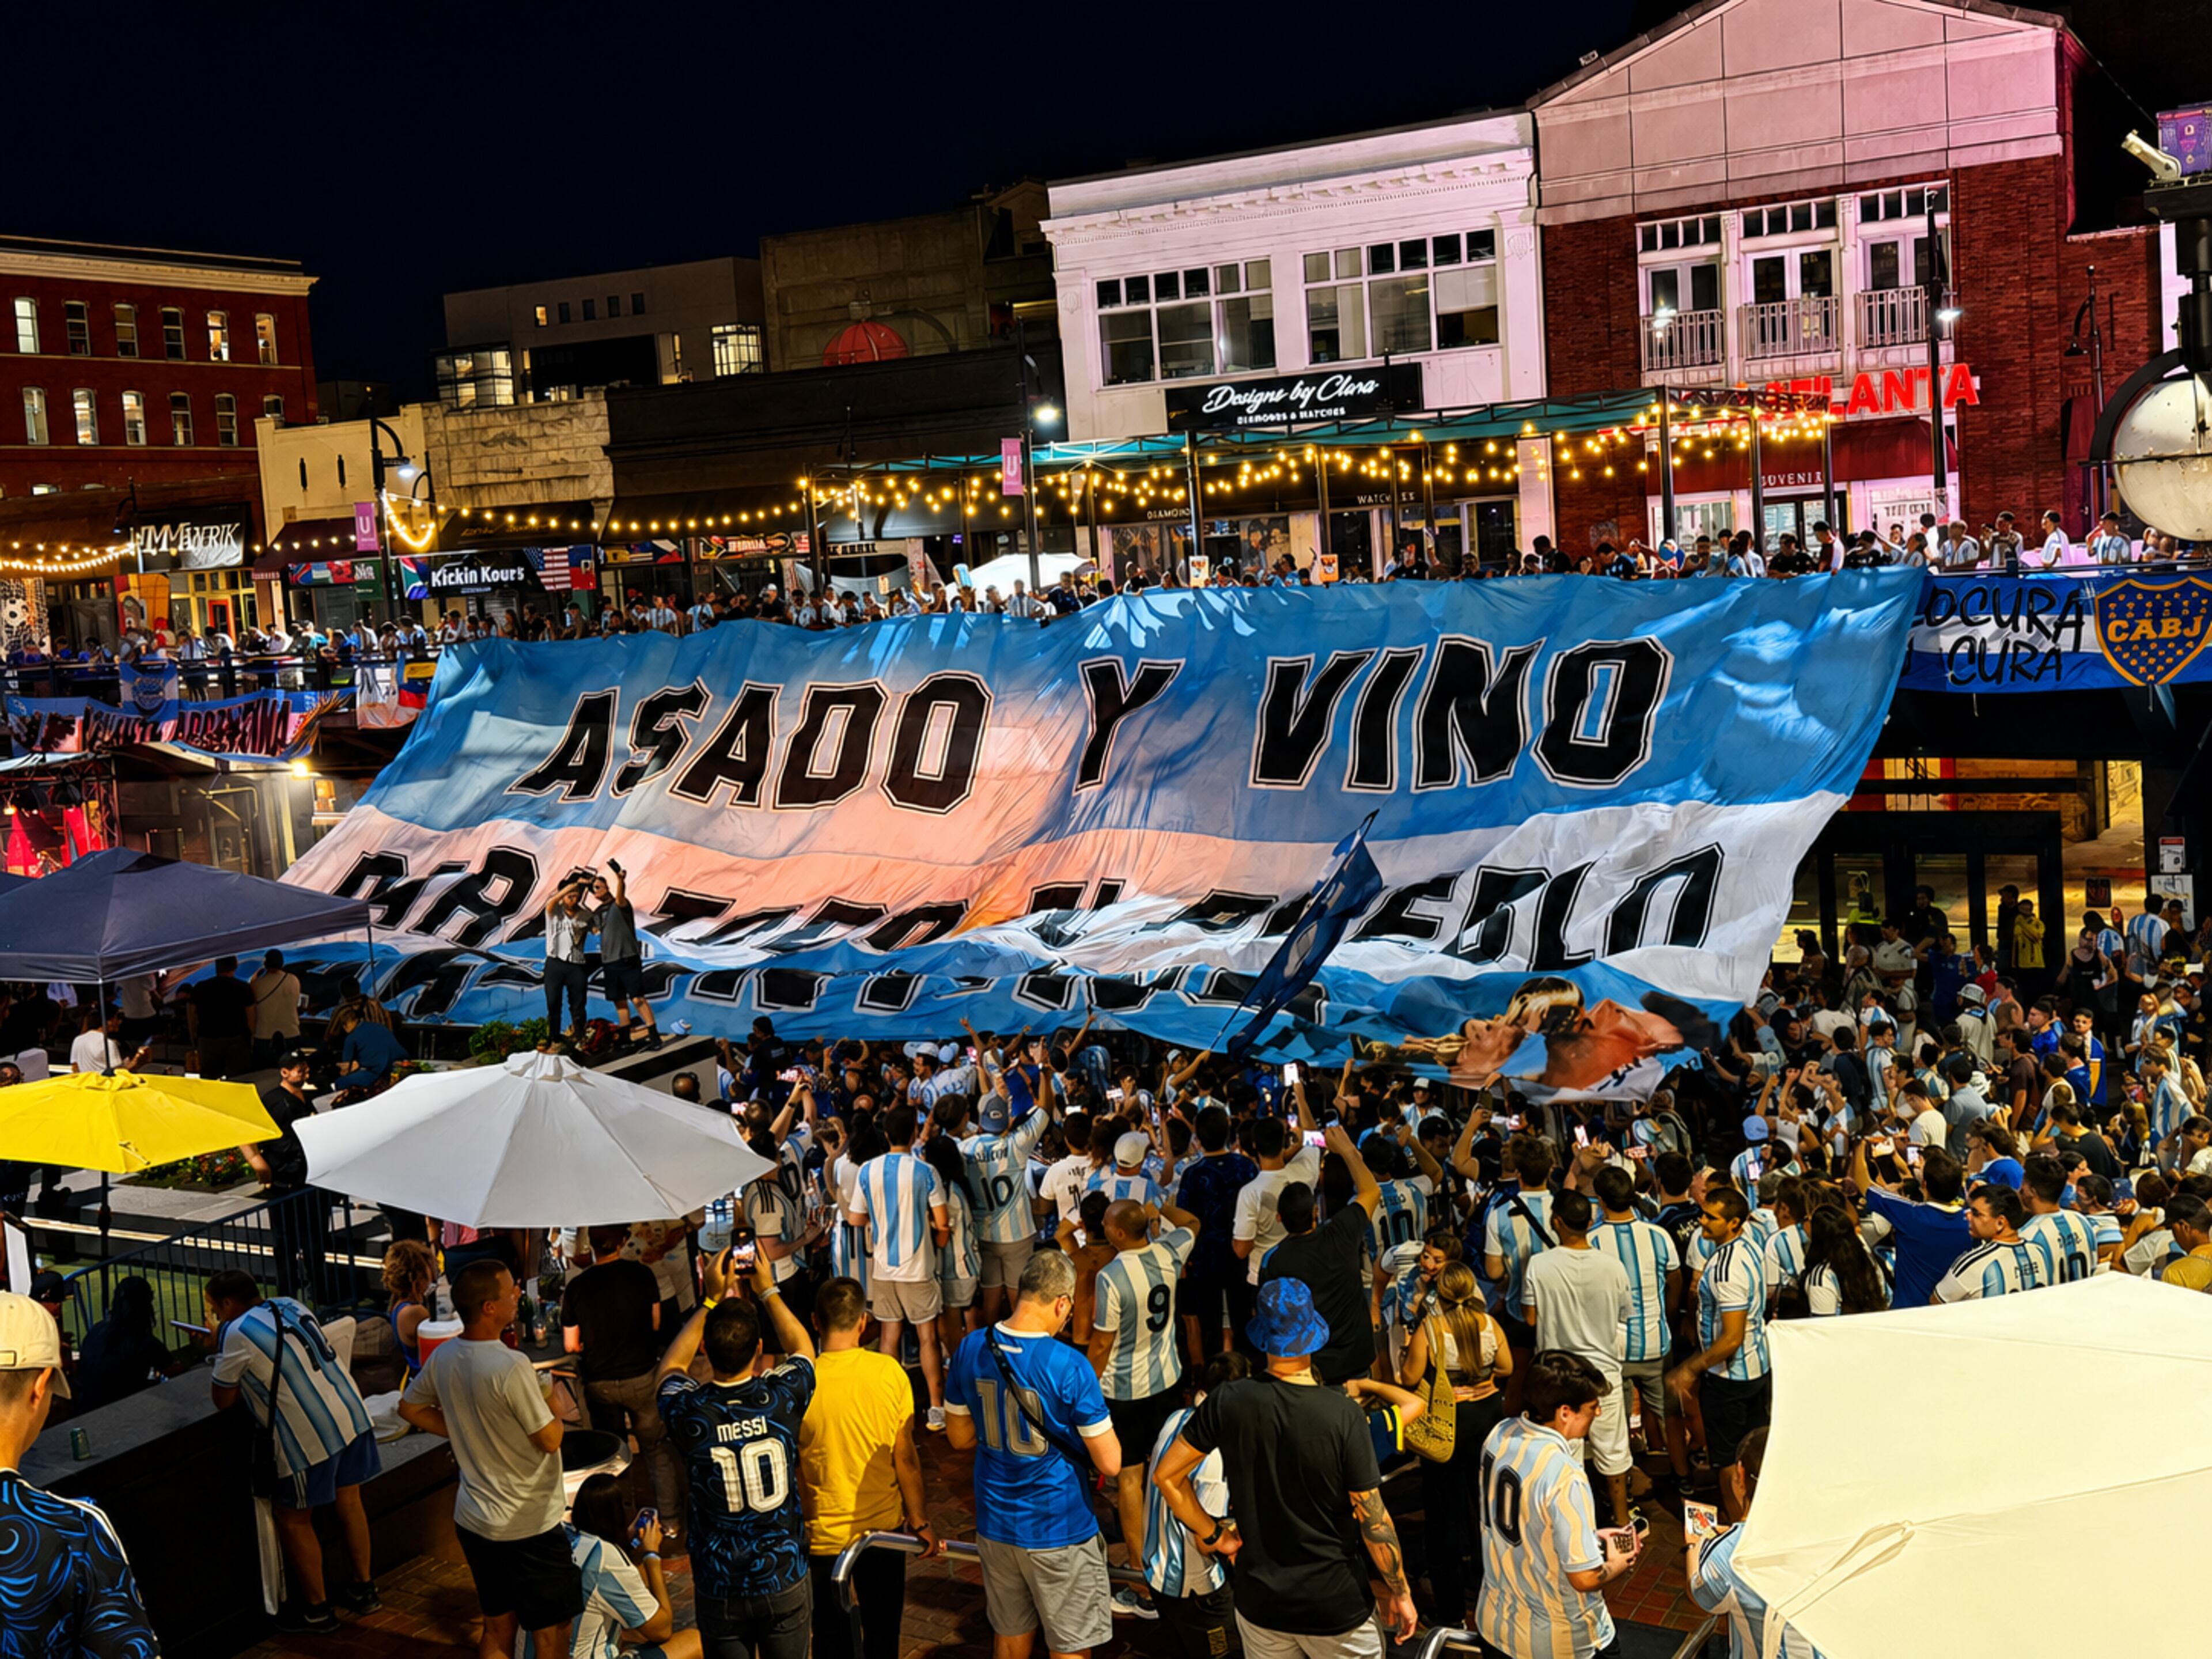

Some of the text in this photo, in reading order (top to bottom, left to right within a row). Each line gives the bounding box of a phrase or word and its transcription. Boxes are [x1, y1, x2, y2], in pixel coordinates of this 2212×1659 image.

[1289, 379, 1316, 409] by
[1006, 455, 1018, 477] U
[359, 516, 370, 535] U
[431, 566, 478, 587] Kickin
[2108, 615, 2204, 643] CABJ
[1948, 636, 2063, 685] CURA
[505, 634, 1675, 816] ASADO Y VINO
[980, 1175, 1014, 1212] 10
[1379, 1209, 1416, 1251] 10
[1146, 1283, 1171, 1333] 9
[717, 1415, 768, 1443] MESSI
[975, 1378, 1049, 1456] 10
[710, 1437, 789, 1513] 10
[1482, 1449, 1522, 1548] 10
